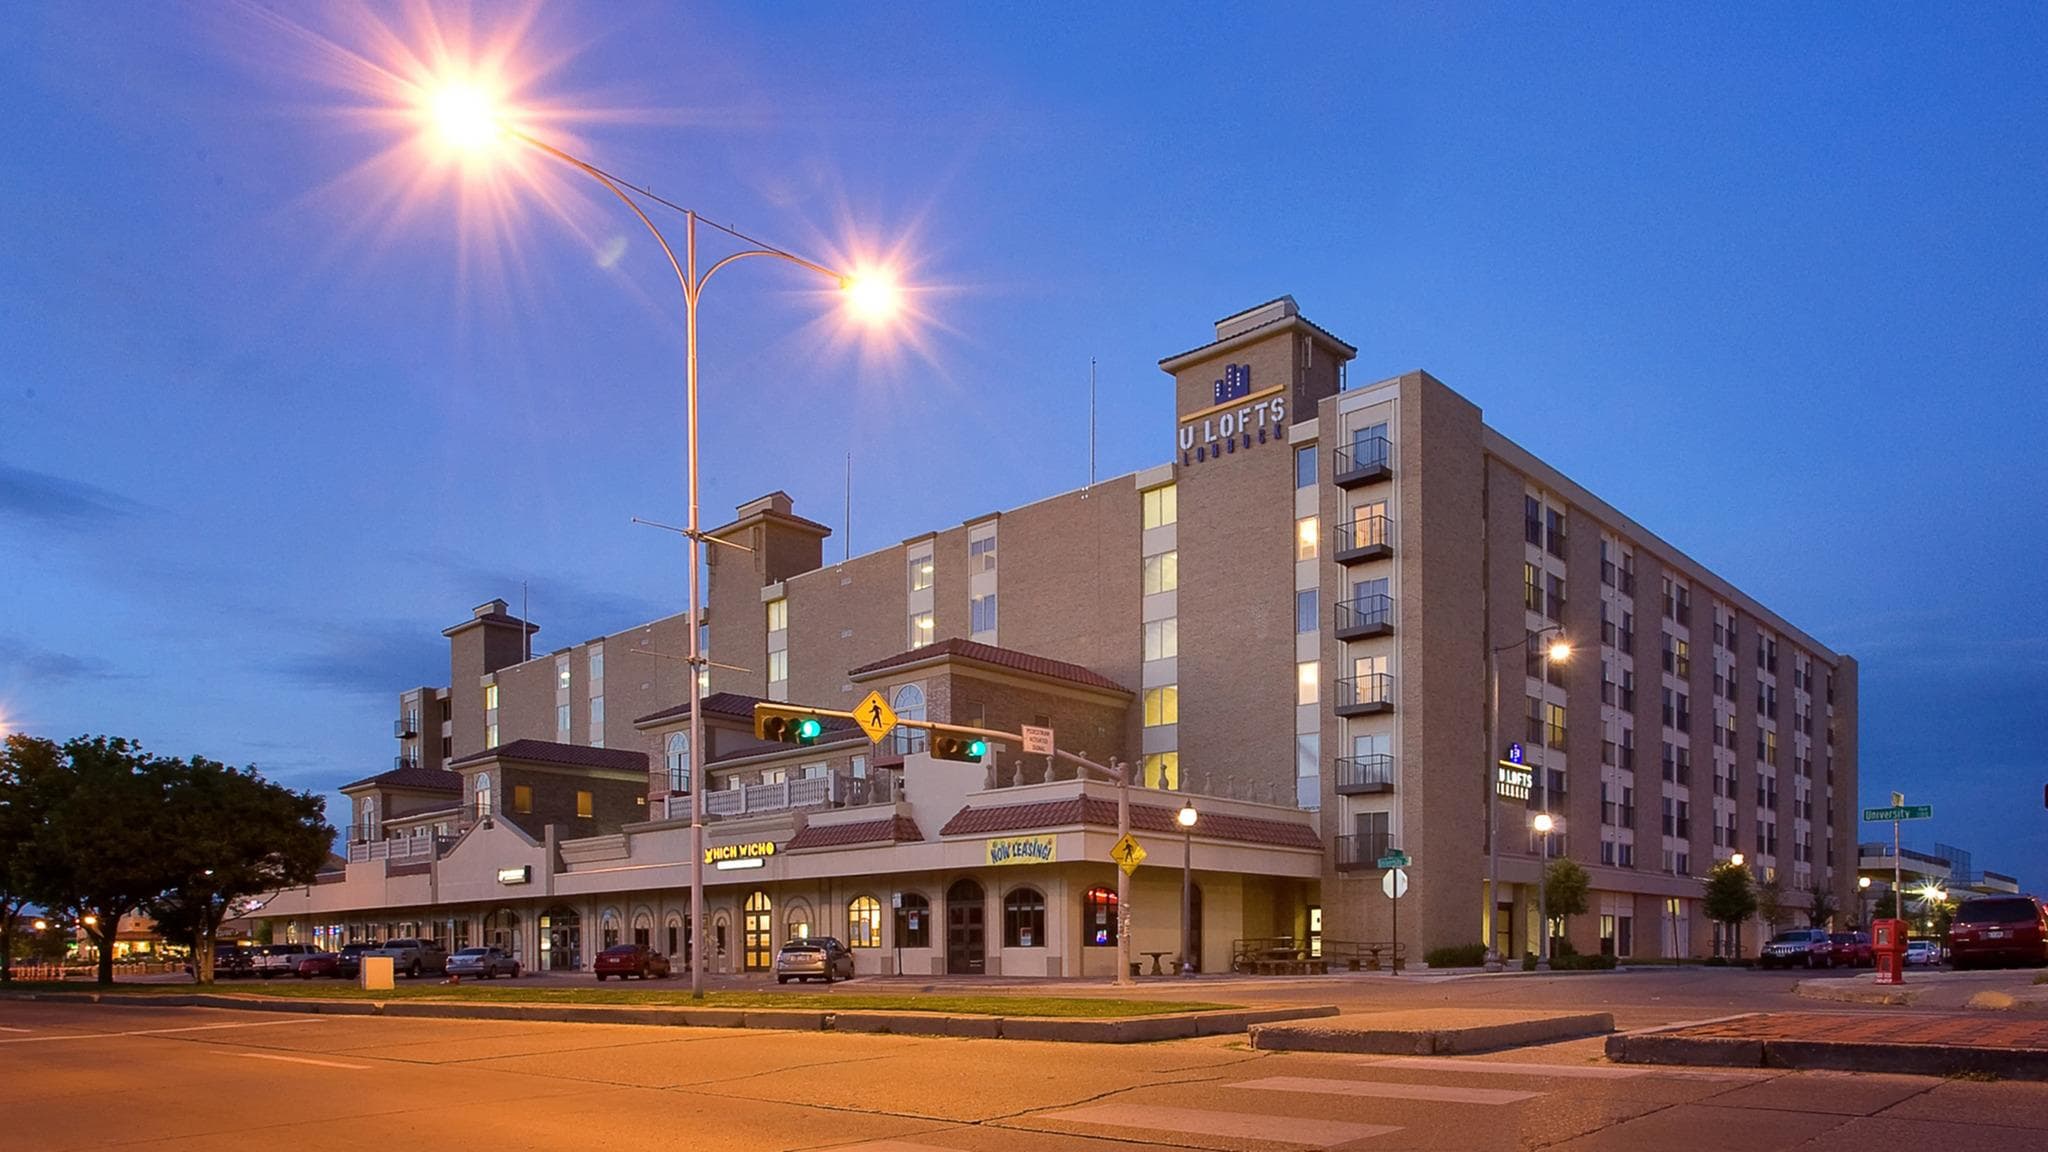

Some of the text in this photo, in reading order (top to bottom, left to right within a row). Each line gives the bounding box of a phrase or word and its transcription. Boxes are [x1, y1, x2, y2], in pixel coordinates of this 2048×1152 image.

[1179, 397, 1285, 450] U LOFTS
[1506, 769, 1533, 788] LOFTS
[1865, 808, 1911, 820] University
[990, 840, 1052, 864] NOW LEASING!
